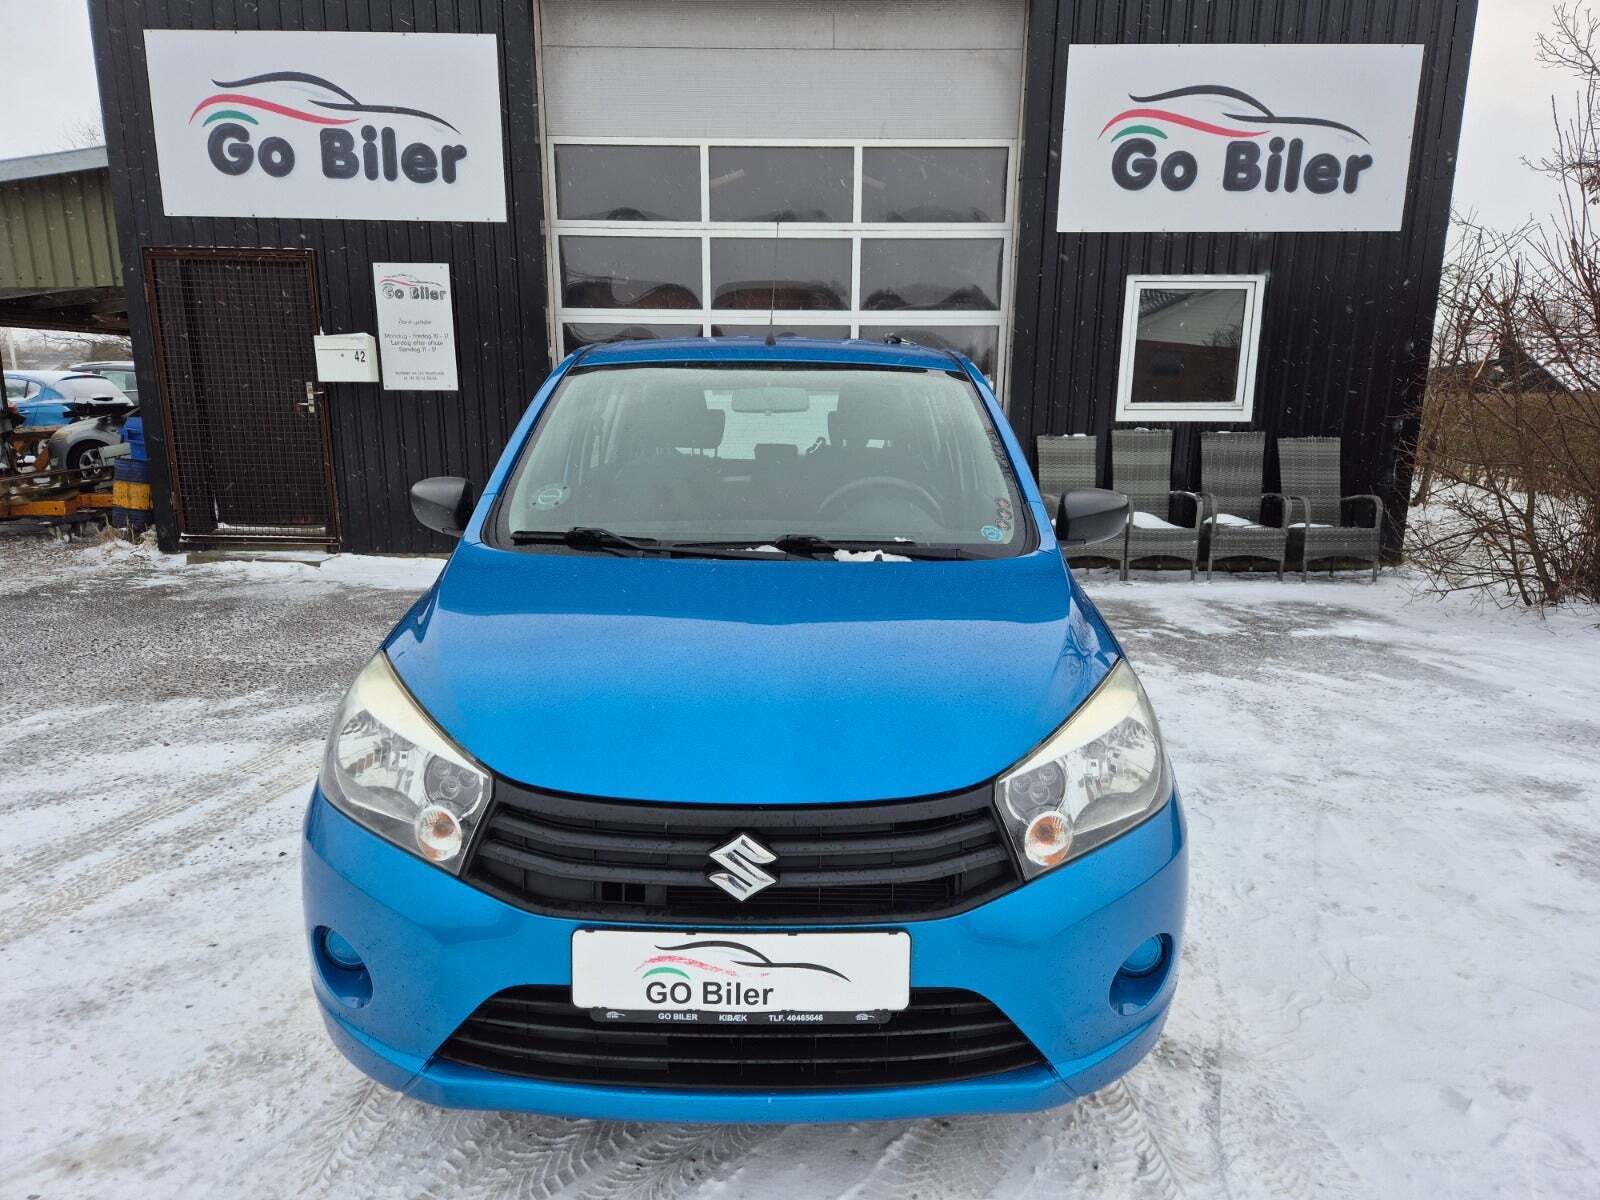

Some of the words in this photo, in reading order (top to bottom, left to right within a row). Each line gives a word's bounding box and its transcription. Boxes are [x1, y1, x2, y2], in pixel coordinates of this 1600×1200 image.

[207, 122, 295, 178] Go
[319, 124, 467, 184] Biler
[1111, 137, 1198, 192] Go
[1222, 136, 1373, 194] Biler
[382, 285, 405, 299] Go
[410, 285, 447, 300] Biler
[354, 350, 366, 363] 42
[645, 981, 692, 1004] GO
[702, 981, 774, 1006] Biler
[657, 1012, 672, 1021] GO
[673, 1012, 699, 1021] BILER
[768, 1014, 785, 1022] TLF.
